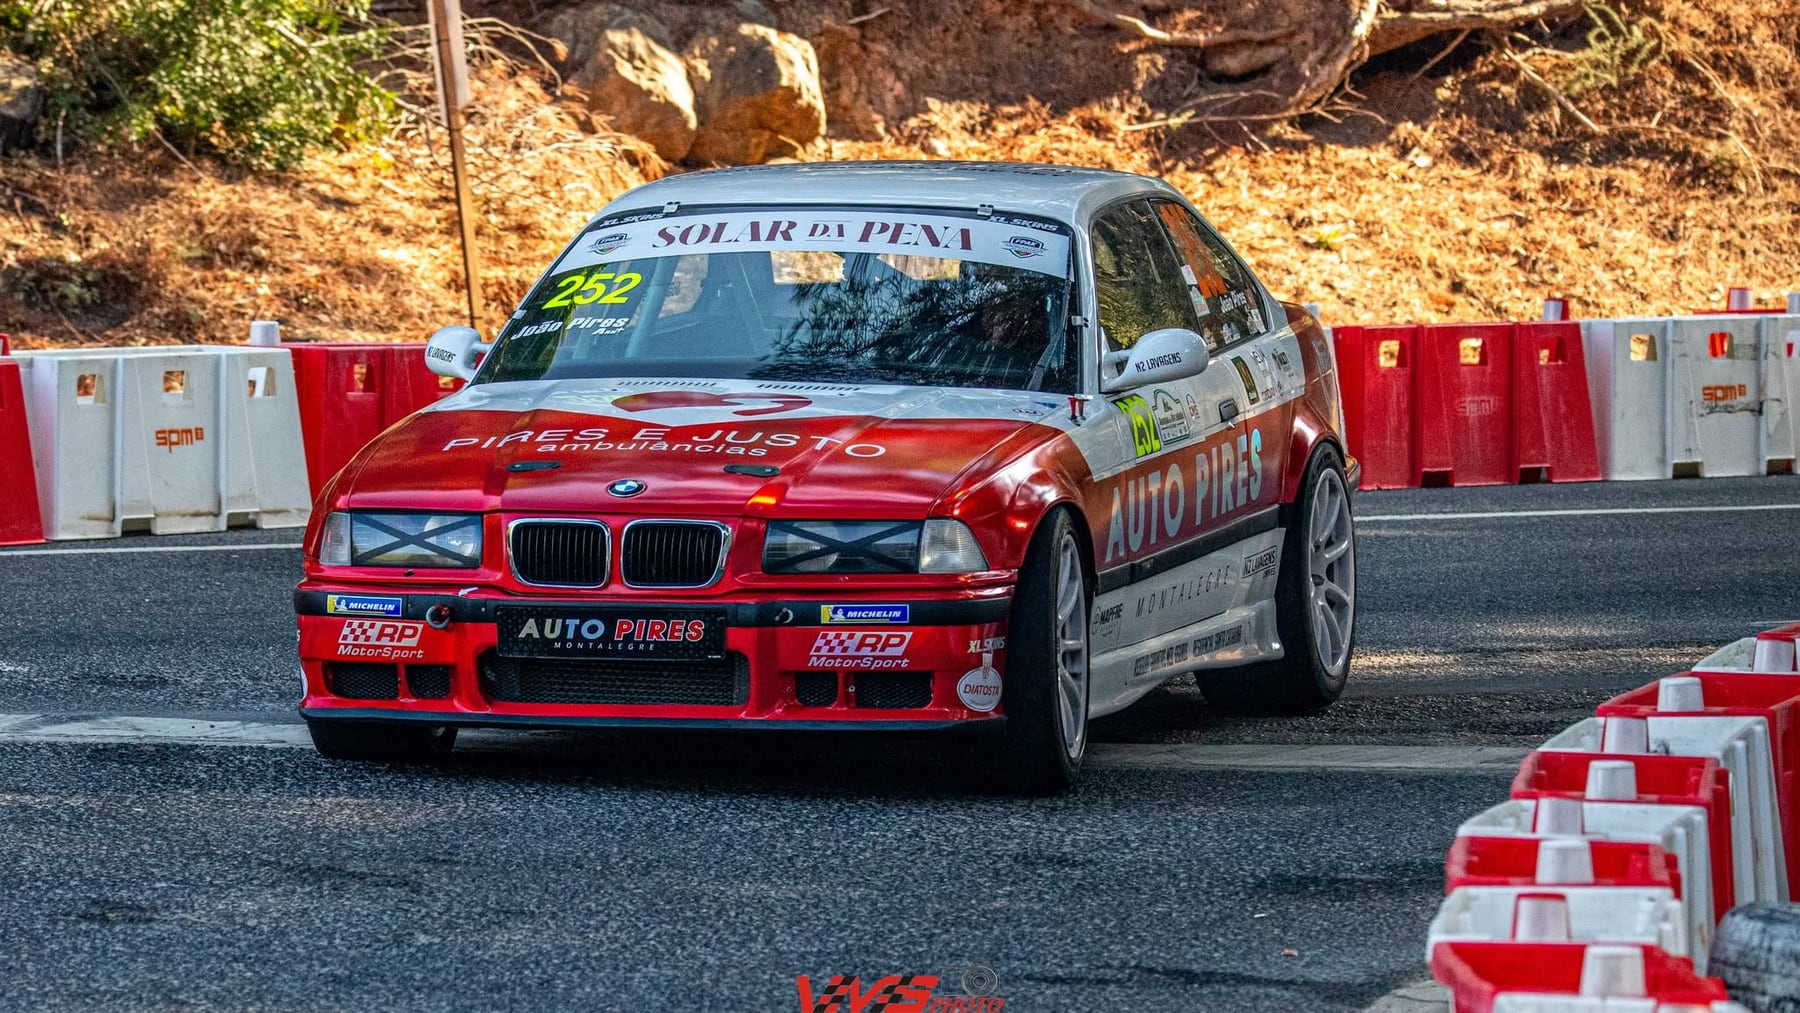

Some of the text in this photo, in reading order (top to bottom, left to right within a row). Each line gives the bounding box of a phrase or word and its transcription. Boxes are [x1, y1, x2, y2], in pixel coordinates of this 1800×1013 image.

[988, 215, 1059, 231] XL SKINS
[652, 220, 797, 248] SOLAR
[808, 221, 846, 239] DA
[858, 221, 972, 251] PENA
[542, 272, 642, 310] 252
[510, 317, 629, 340] João Pires
[1146, 352, 1182, 370] LAVAGENS
[1702, 384, 1737, 403] spm
[155, 428, 194, 453] spm
[443, 428, 886, 458] PIRES E JUSTO
[536, 440, 768, 458] ambulâncias
[1105, 428, 1262, 563] AUTO PIRES
[1135, 565, 1232, 618] MONTALEGRE
[348, 602, 396, 612] MICHELIN
[846, 610, 902, 619] MICHELIN
[376, 623, 419, 644] RP
[518, 618, 705, 641] AUTO PIRES
[337, 645, 424, 660] MotorSport
[554, 641, 655, 651] MONTALEGRE
[854, 633, 907, 653] RP
[807, 656, 910, 670] MotorSport
